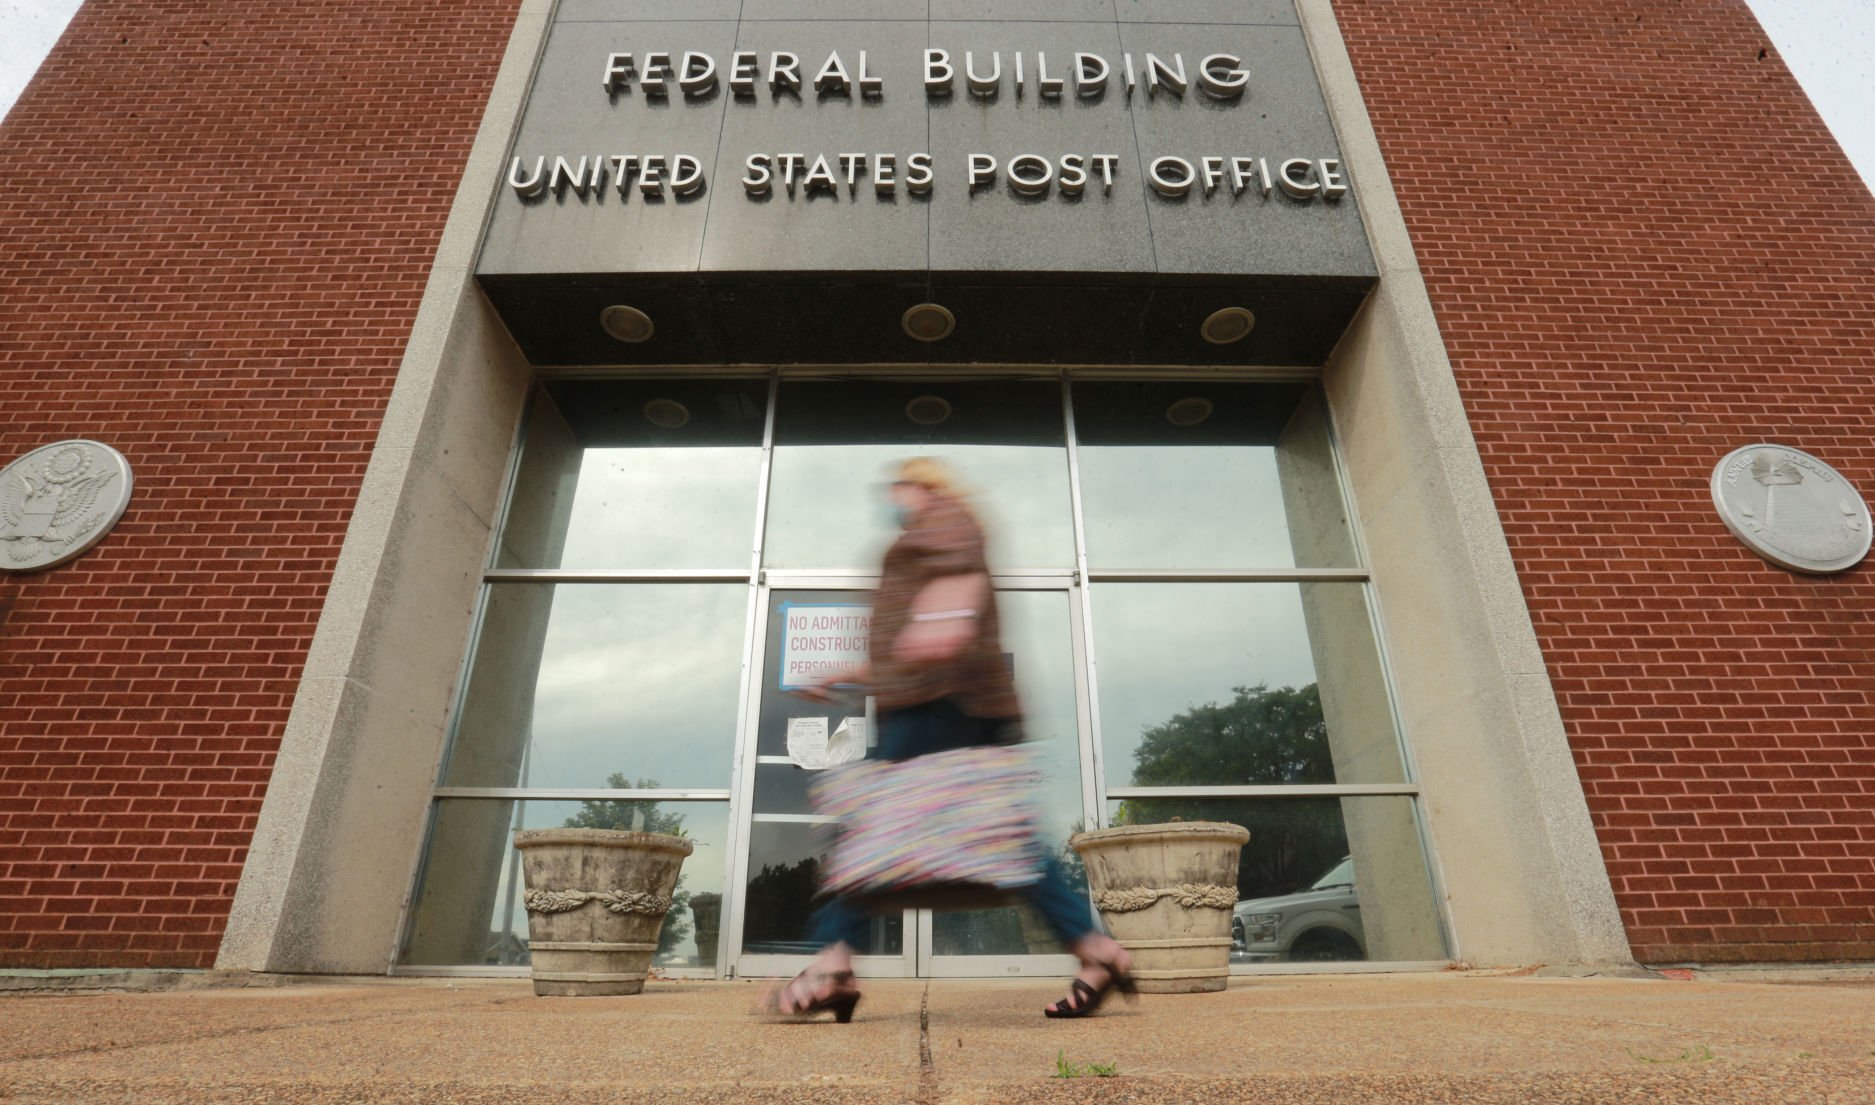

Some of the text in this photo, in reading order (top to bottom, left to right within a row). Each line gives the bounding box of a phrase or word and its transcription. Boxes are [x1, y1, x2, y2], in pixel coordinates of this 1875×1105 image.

[602, 48, 1251, 97] FEDERAL BUILDING
[508, 152, 1348, 199] UNITED STATES POST OFFICE
[789, 616, 808, 630] NO
